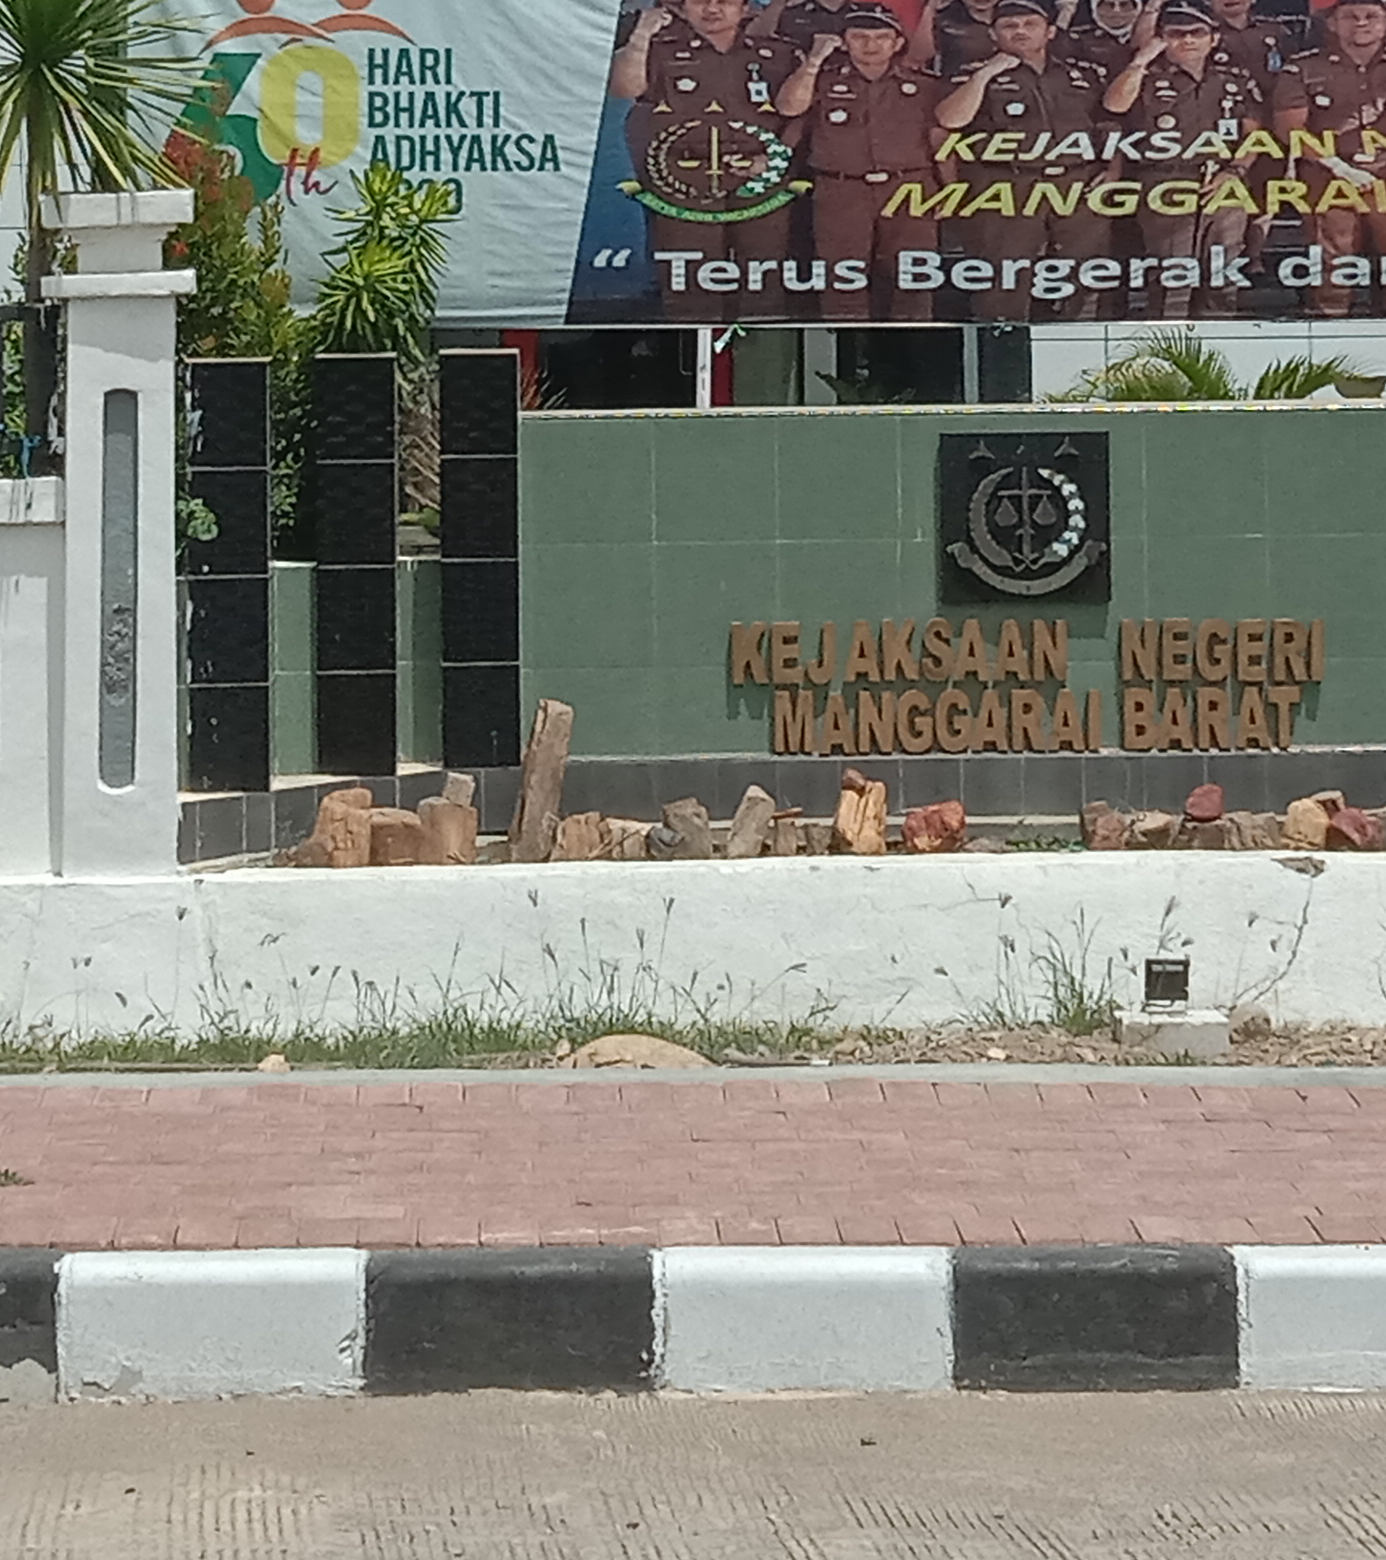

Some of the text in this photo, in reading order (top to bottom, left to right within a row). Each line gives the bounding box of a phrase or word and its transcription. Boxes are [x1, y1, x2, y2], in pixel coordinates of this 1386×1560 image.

[367, 47, 453, 86] HARI
[367, 90, 501, 129] BHAKTI
[369, 133, 561, 172] ADHYAKSA
[934, 128, 1337, 162] KEJAKSAAN
[653, 250, 869, 291] Terus
[897, 245, 1253, 300] Bergerak
[727, 616, 1326, 686] KEJAKSAAN NEGERI
[771, 684, 1303, 756] MANGGARAI BARAT
